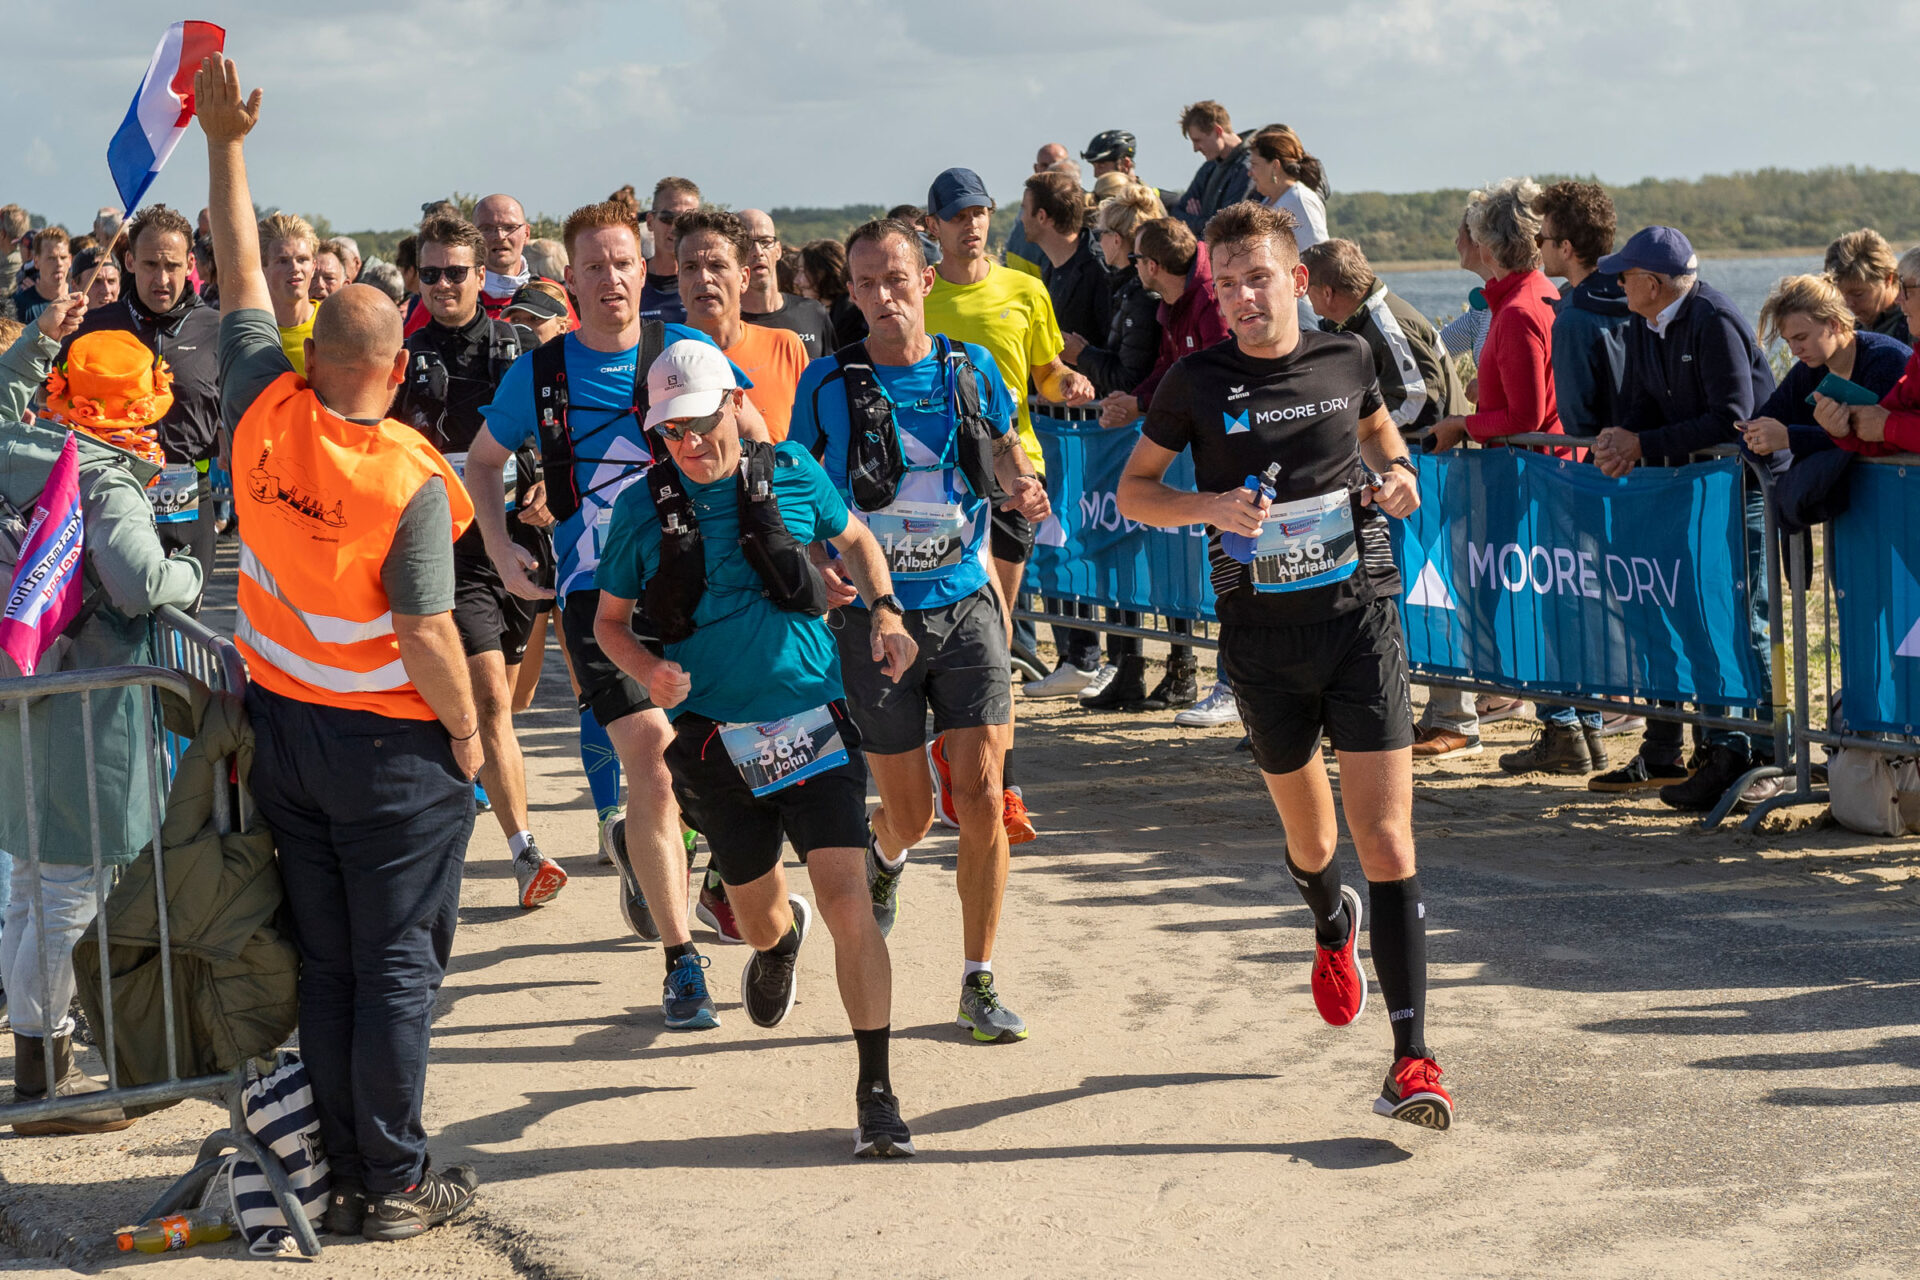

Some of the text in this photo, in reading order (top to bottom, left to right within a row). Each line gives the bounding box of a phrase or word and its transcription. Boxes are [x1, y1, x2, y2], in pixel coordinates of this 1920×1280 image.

[600, 365, 629, 374] CRAFT
[1227, 391, 1250, 401] erima
[1255, 397, 1349, 425] MOORE DRV
[883, 532, 950, 558] 1440
[1284, 534, 1326, 564] 36
[896, 555, 938, 569] Albert
[1278, 558, 1336, 577] Adriaan
[1468, 541, 1681, 608] MOORE DRV
[754, 726, 814, 766] 384
[774, 750, 808, 774] John
